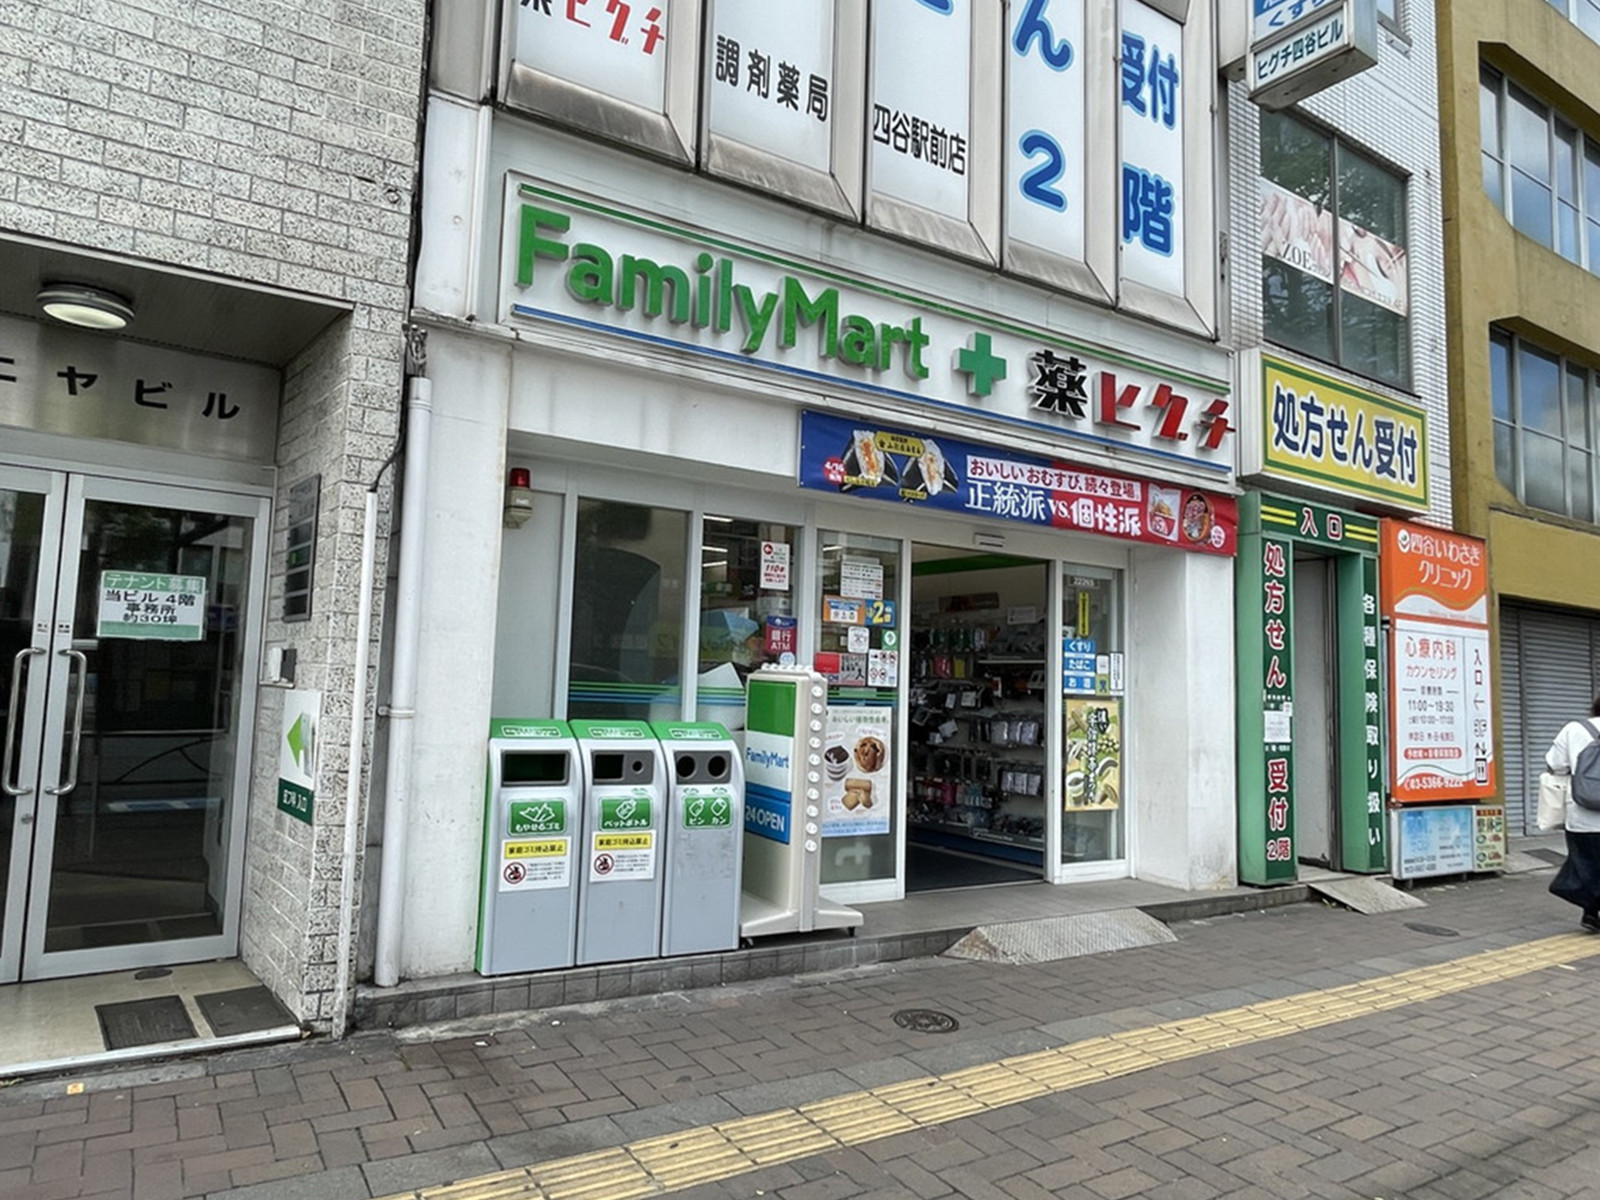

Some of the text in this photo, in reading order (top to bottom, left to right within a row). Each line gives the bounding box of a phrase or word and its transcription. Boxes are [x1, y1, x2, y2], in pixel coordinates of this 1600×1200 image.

[521, 0, 666, 55] ヒグチ
[714, 34, 830, 123] 調剤薬局
[1121, 28, 1180, 131] 受付
[873, 102, 967, 176] 四谷駅前店
[513, 203, 931, 381] FamilyMart
[1028, 349, 1237, 450] 薬ヒグチ
[1271, 383, 1418, 486] 処方せん受付
[965, 479, 1047, 520] 正統派
[1071, 496, 1143, 538] 個性派
[1300, 507, 1342, 540] 入口
[1410, 532, 1481, 567] 四谷いわさき
[1418, 560, 1472, 591] クリニック
[105, 589, 196, 607] 当ビル 4階
[125, 602, 175, 615] 事務所
[1264, 541, 1286, 688] 処方せん
[122, 612, 178, 624] 約30坪
[770, 641, 791, 651] ATM
[1068, 641, 1092, 652] くすり
[1405, 635, 1457, 661] 心療内科
[1068, 659, 1091, 670] たばこ
[1405, 665, 1458, 681] カウンセリング
[745, 747, 790, 769] FamilyMart
[1267, 758, 1289, 832] 受付
